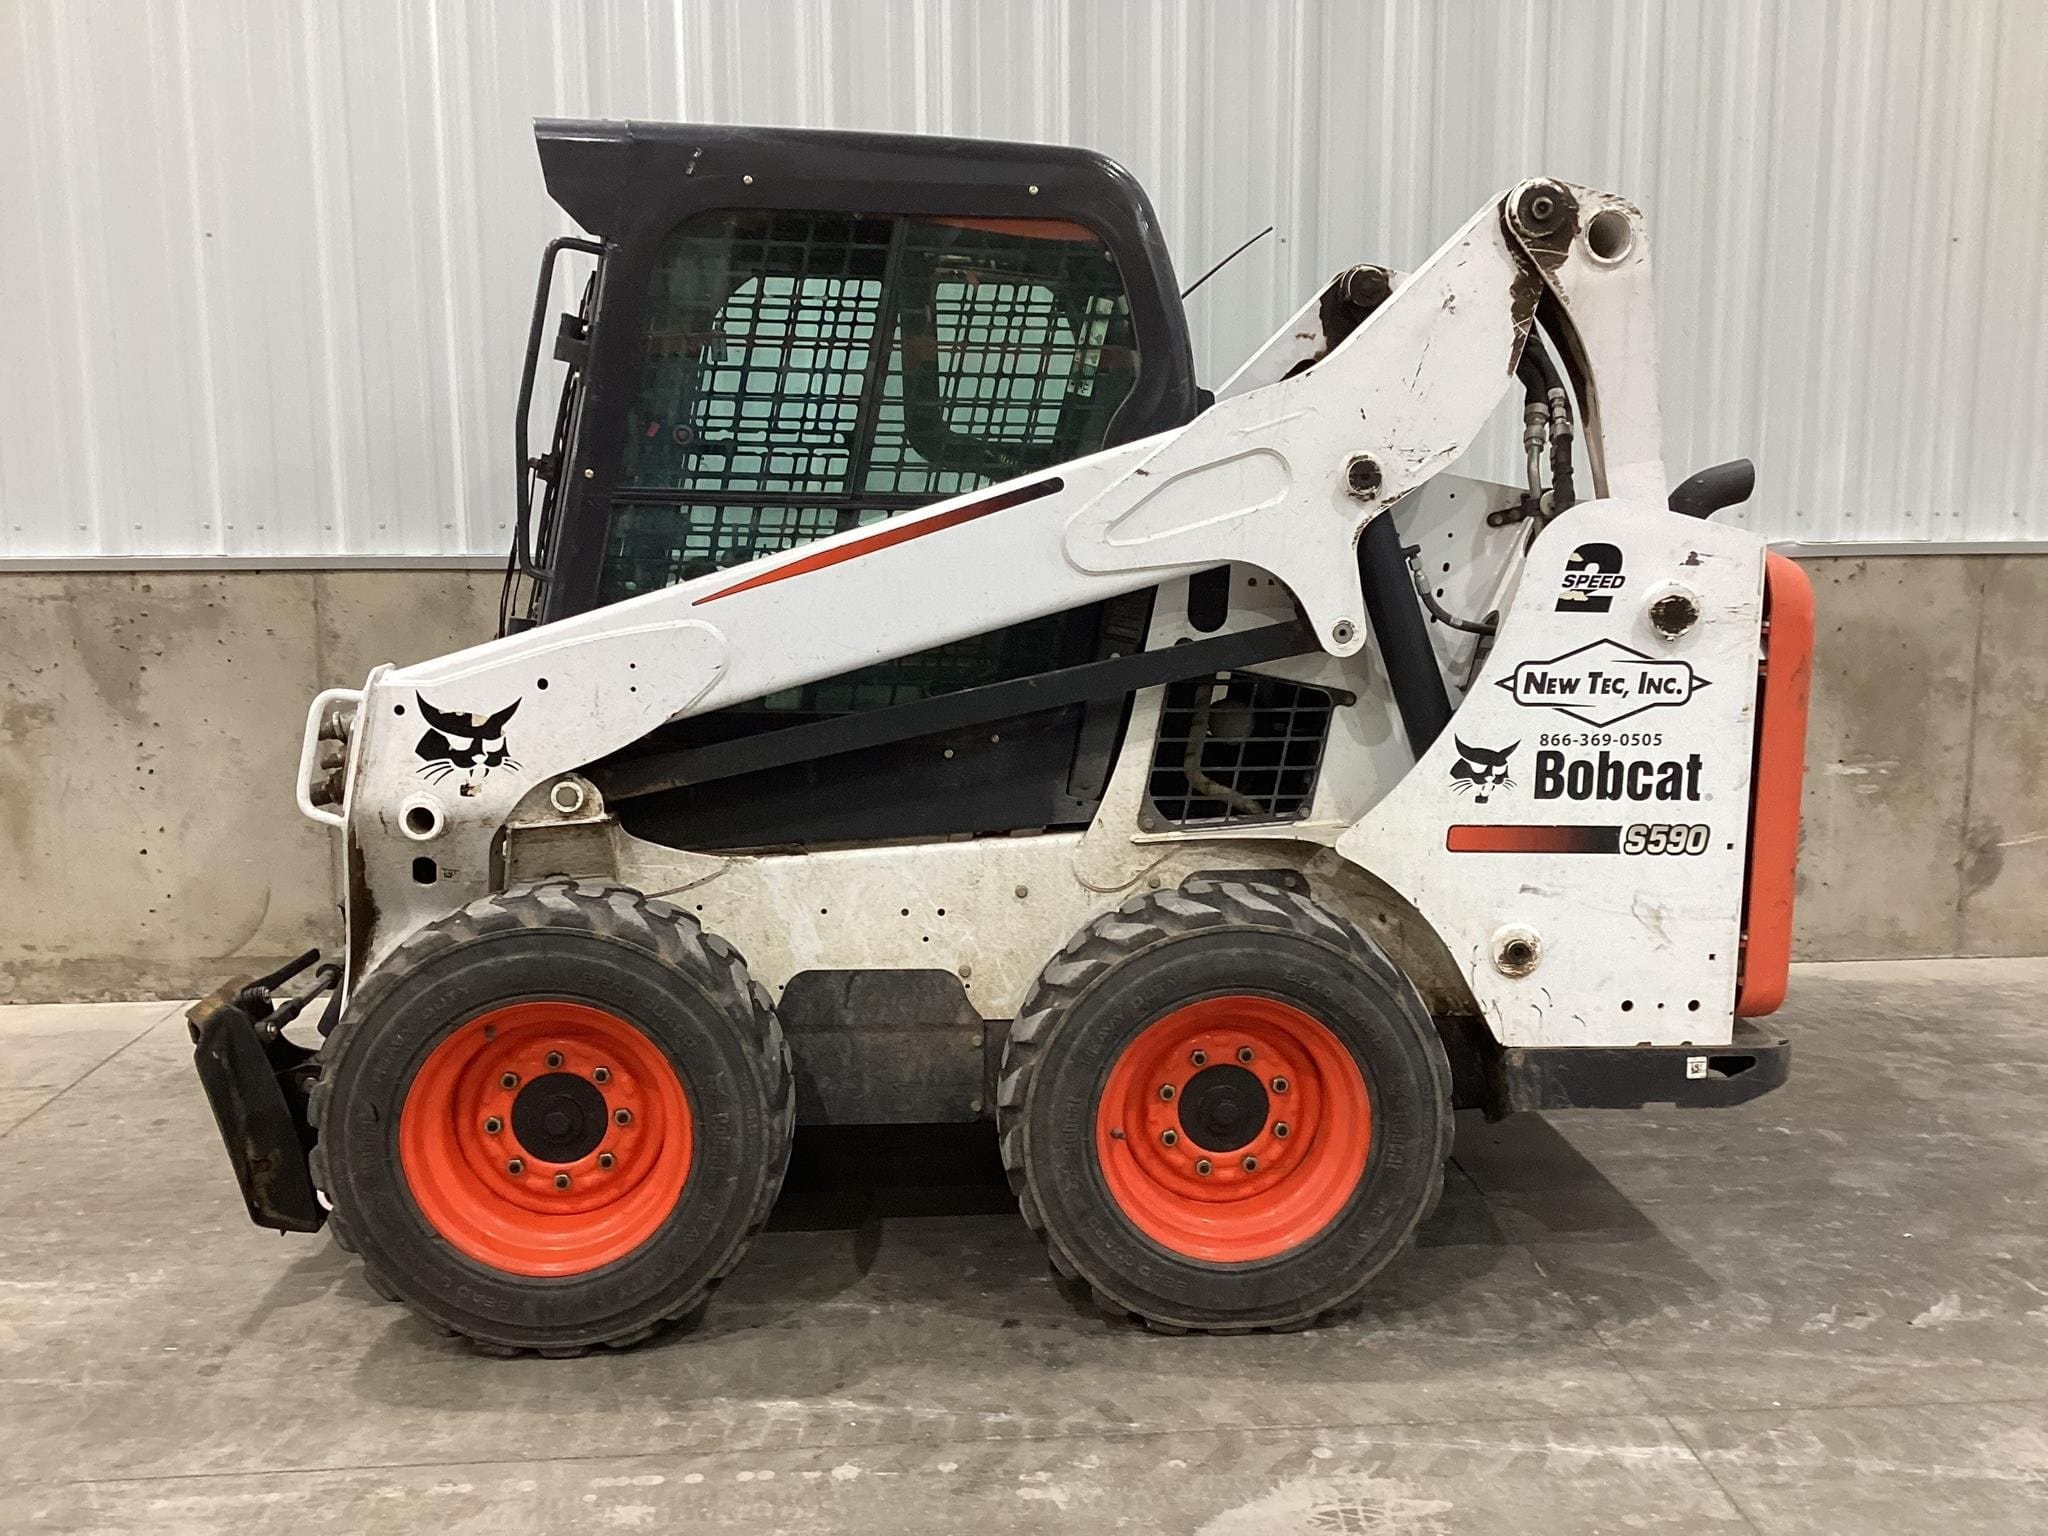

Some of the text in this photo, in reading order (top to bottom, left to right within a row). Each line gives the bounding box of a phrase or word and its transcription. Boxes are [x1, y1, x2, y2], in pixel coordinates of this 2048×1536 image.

[1554, 542, 1624, 613] 2
[1561, 574, 1626, 590] SPEED
[1539, 733, 1663, 747] 866-369-0505
[1533, 750, 1703, 801] Bobcat
[1623, 823, 1711, 855] S590
